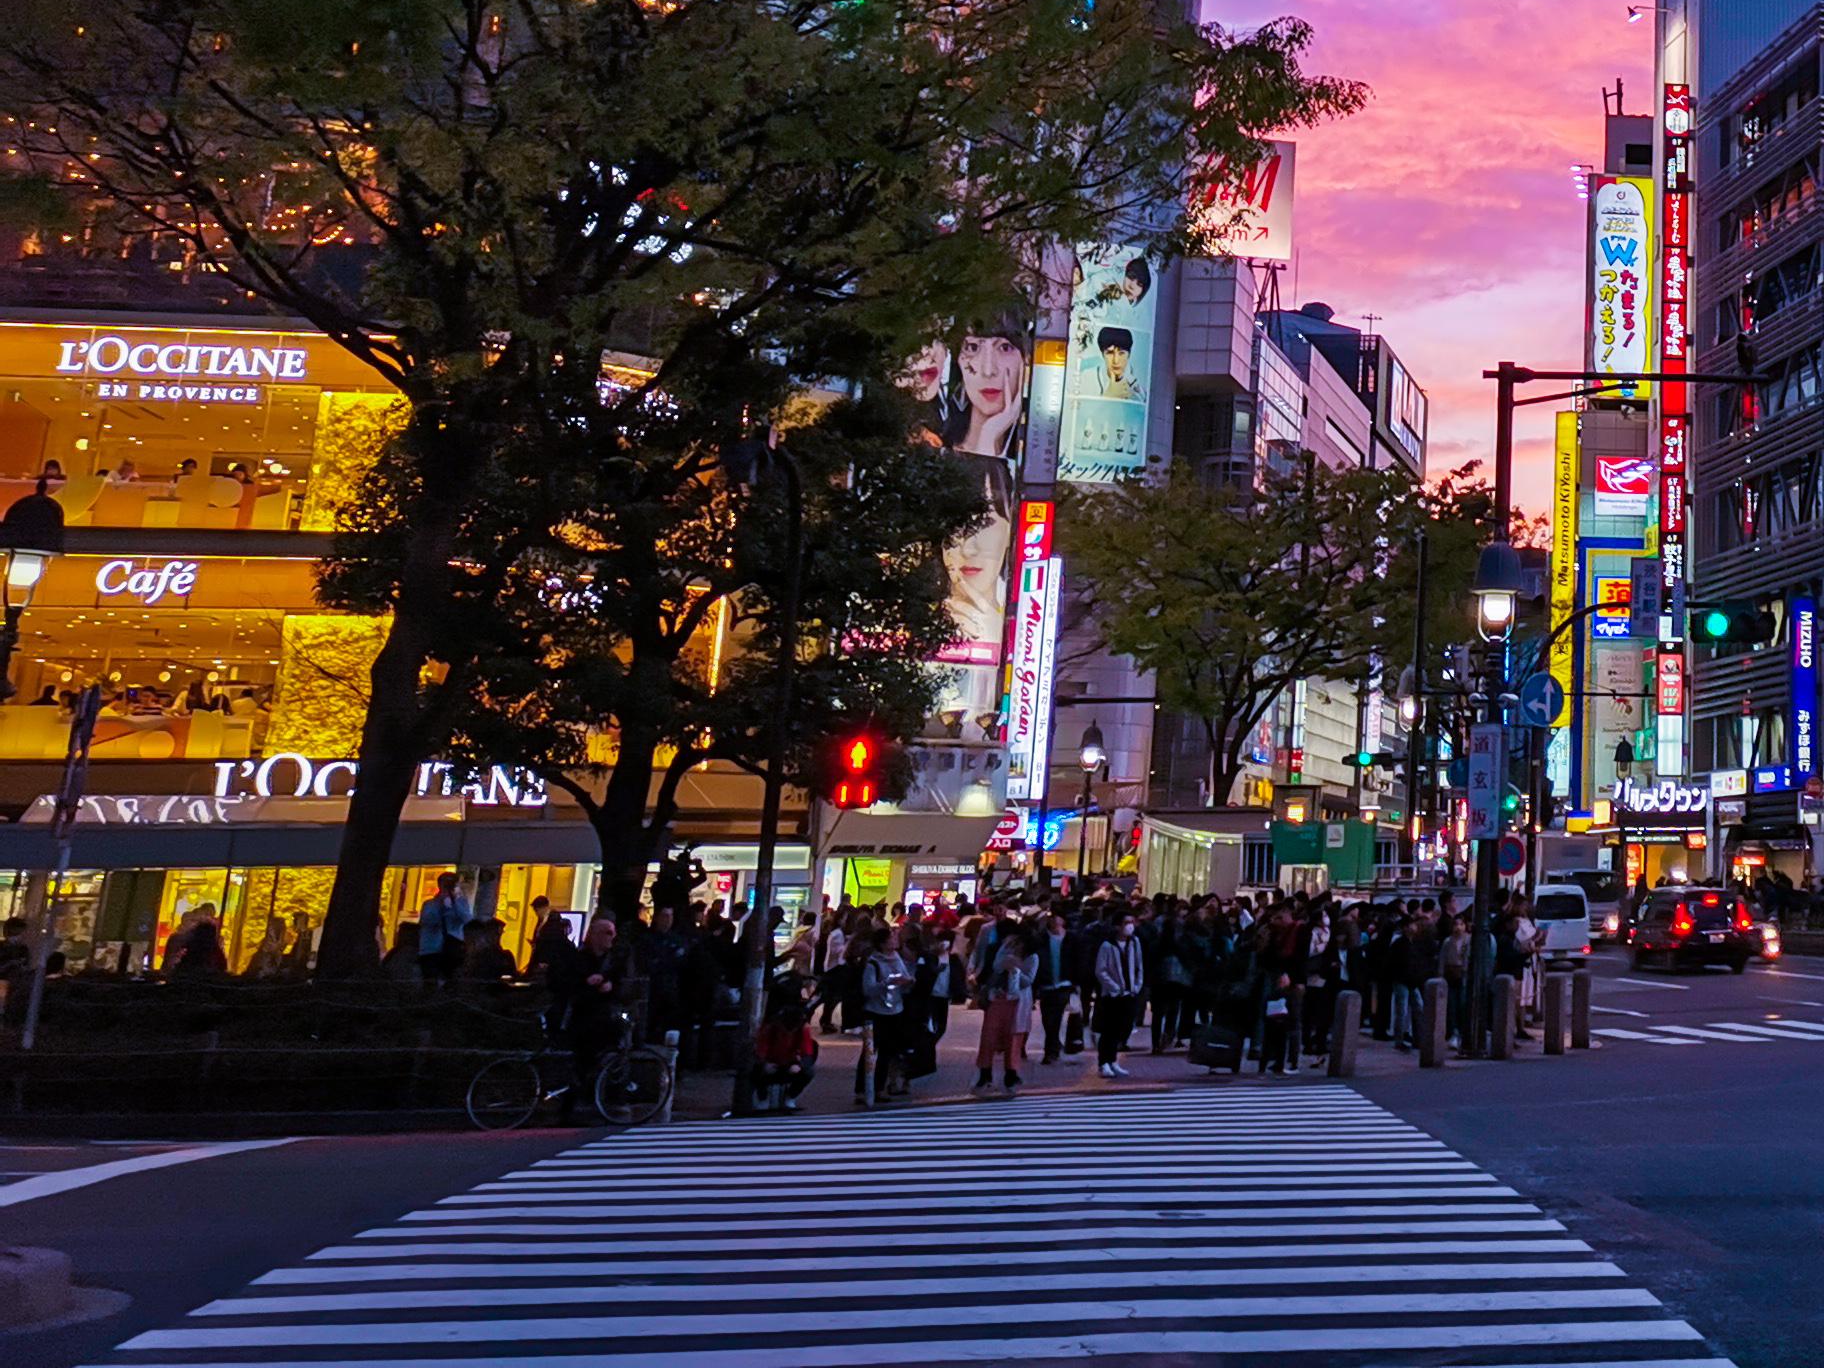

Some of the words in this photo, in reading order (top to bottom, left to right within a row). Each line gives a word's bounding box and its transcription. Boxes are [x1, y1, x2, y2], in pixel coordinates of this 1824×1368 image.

[57, 336, 306, 379] L'OCCITANE
[98, 383, 126, 399] EN
[139, 384, 258, 402] PROVENCE
[1561, 452, 1572, 504] KiYoshi
[1558, 504, 1571, 587] Matsumoto
[96, 560, 197, 604] Café
[1800, 611, 1813, 668] MIZUHO
[213, 752, 549, 807] L'OCITANE
